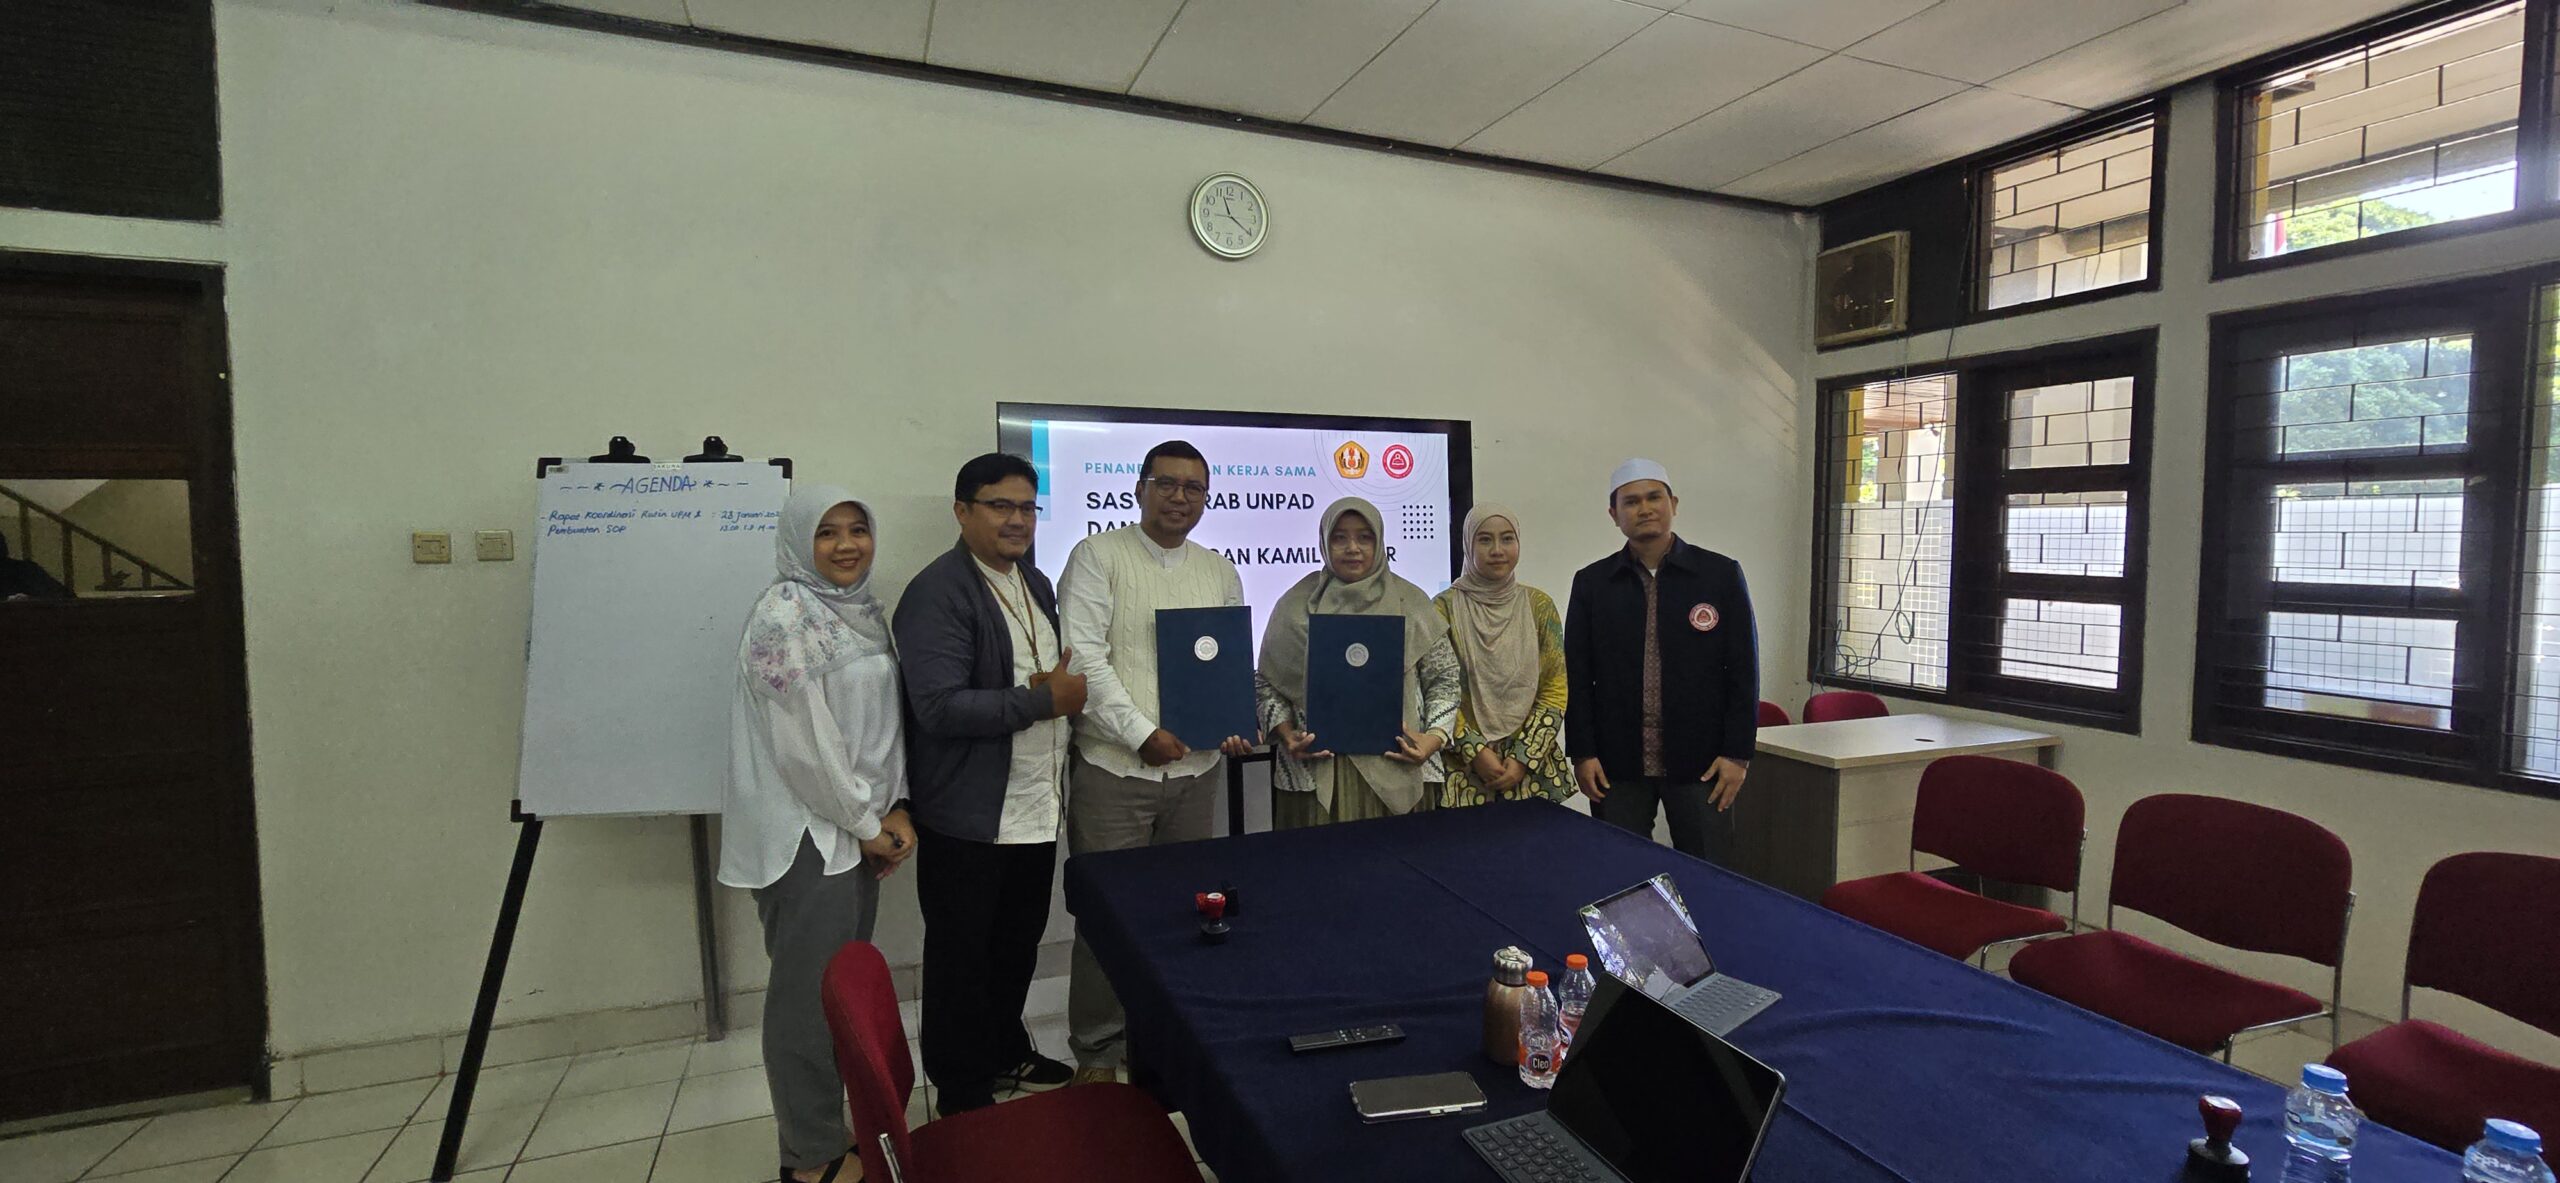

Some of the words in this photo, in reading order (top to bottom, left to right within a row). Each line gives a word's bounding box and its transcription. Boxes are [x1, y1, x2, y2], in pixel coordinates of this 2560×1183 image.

[1216, 187, 1223, 197] 11
[1226, 186, 1234, 197] 12
[1205, 195, 1216, 206] 10
[1247, 201, 1254, 212] 2
[1202, 207, 1210, 218] 9
[1250, 214, 1257, 225] 3
[1206, 221, 1213, 232] 8
[1214, 231, 1221, 241] 7
[1226, 236, 1233, 247] 6
[1237, 234, 1244, 246] 5
[1227, 464, 1270, 476] KERJA
[1275, 465, 1317, 477] SAMA
[620, 475, 693, 494] AGENDA
[1204, 493, 1241, 510] RAB
[1246, 493, 1315, 510] UNPAD
[606, 525, 627, 534] SOP
[1257, 547, 1321, 564] KAMIL
[1532, 1057, 1549, 1070] Cleo
